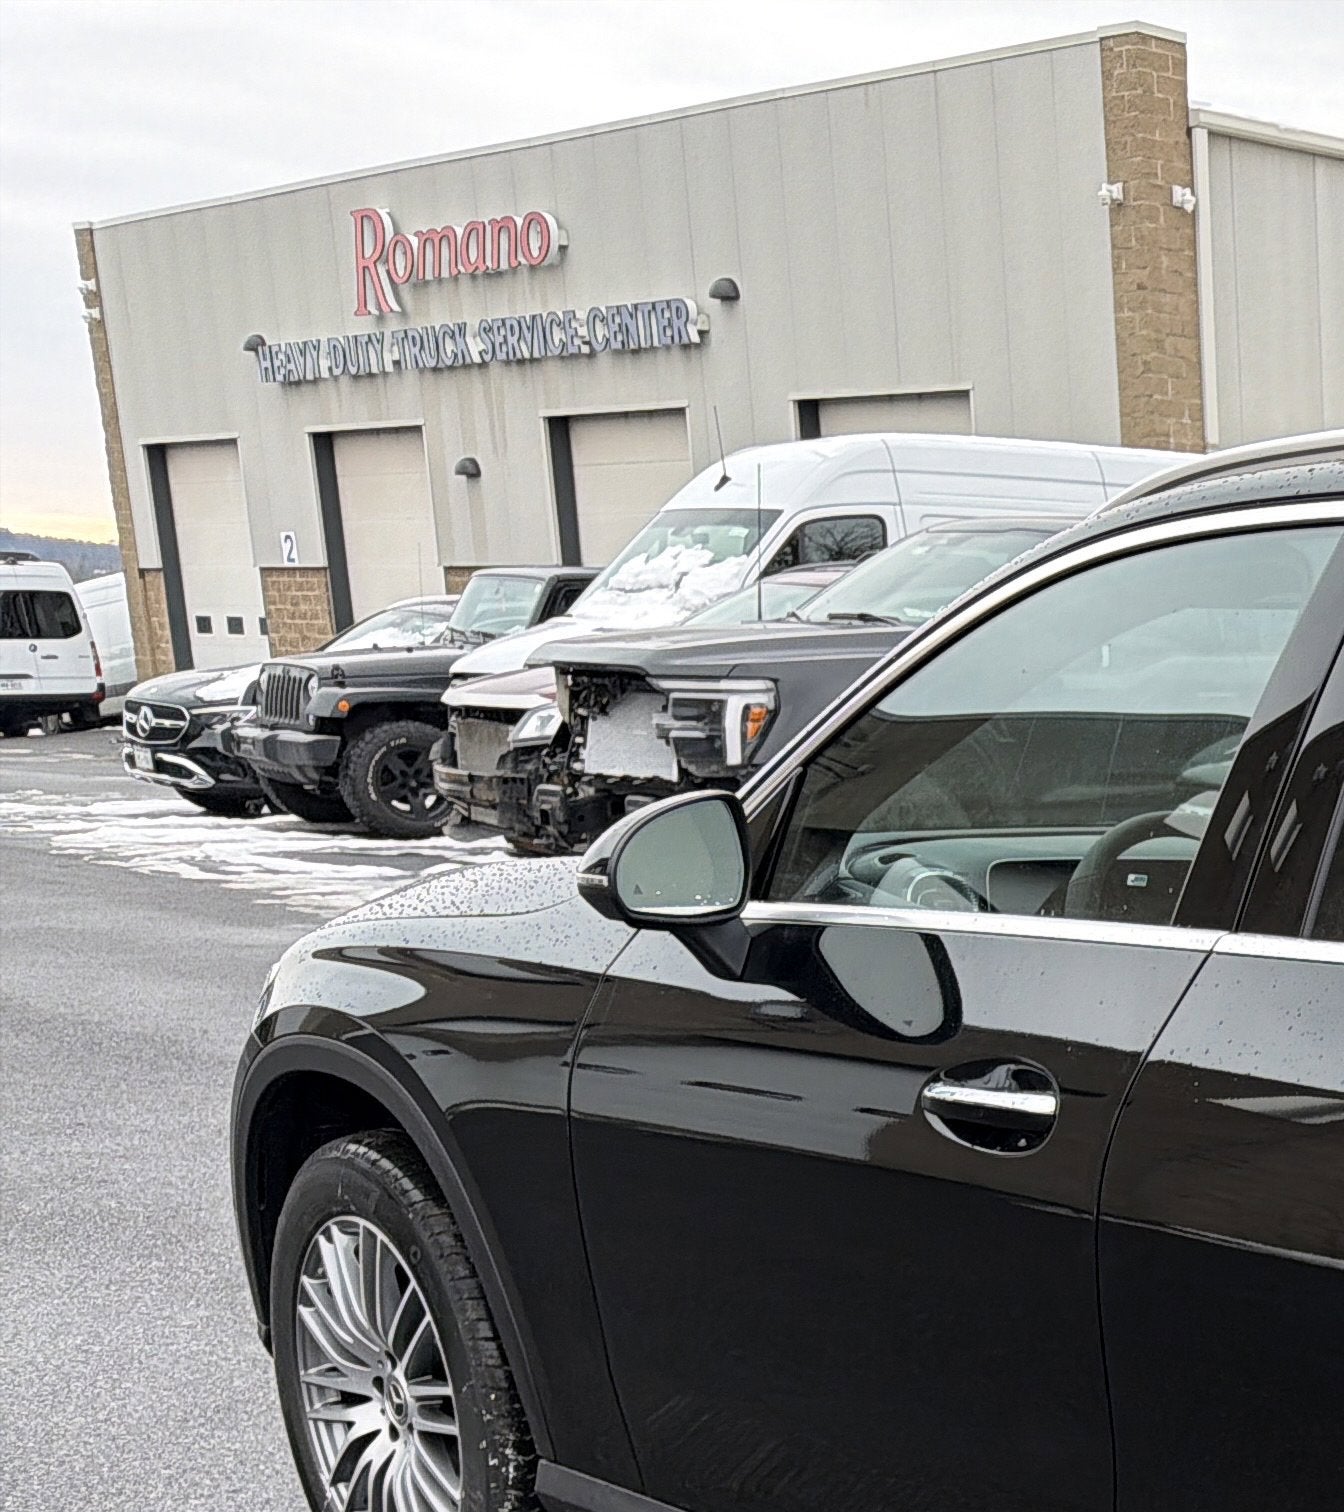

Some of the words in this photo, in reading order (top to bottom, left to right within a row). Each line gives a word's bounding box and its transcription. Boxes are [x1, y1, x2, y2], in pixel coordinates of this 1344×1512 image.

[350, 208, 556, 316] Romano
[257, 339, 322, 384] HEAVY
[327, 330, 386, 377] DUTY
[392, 320, 474, 370] TRUCK
[478, 309, 582, 363] SERVICE
[586, 298, 697, 353] CENTER
[284, 534, 296, 563] 2
